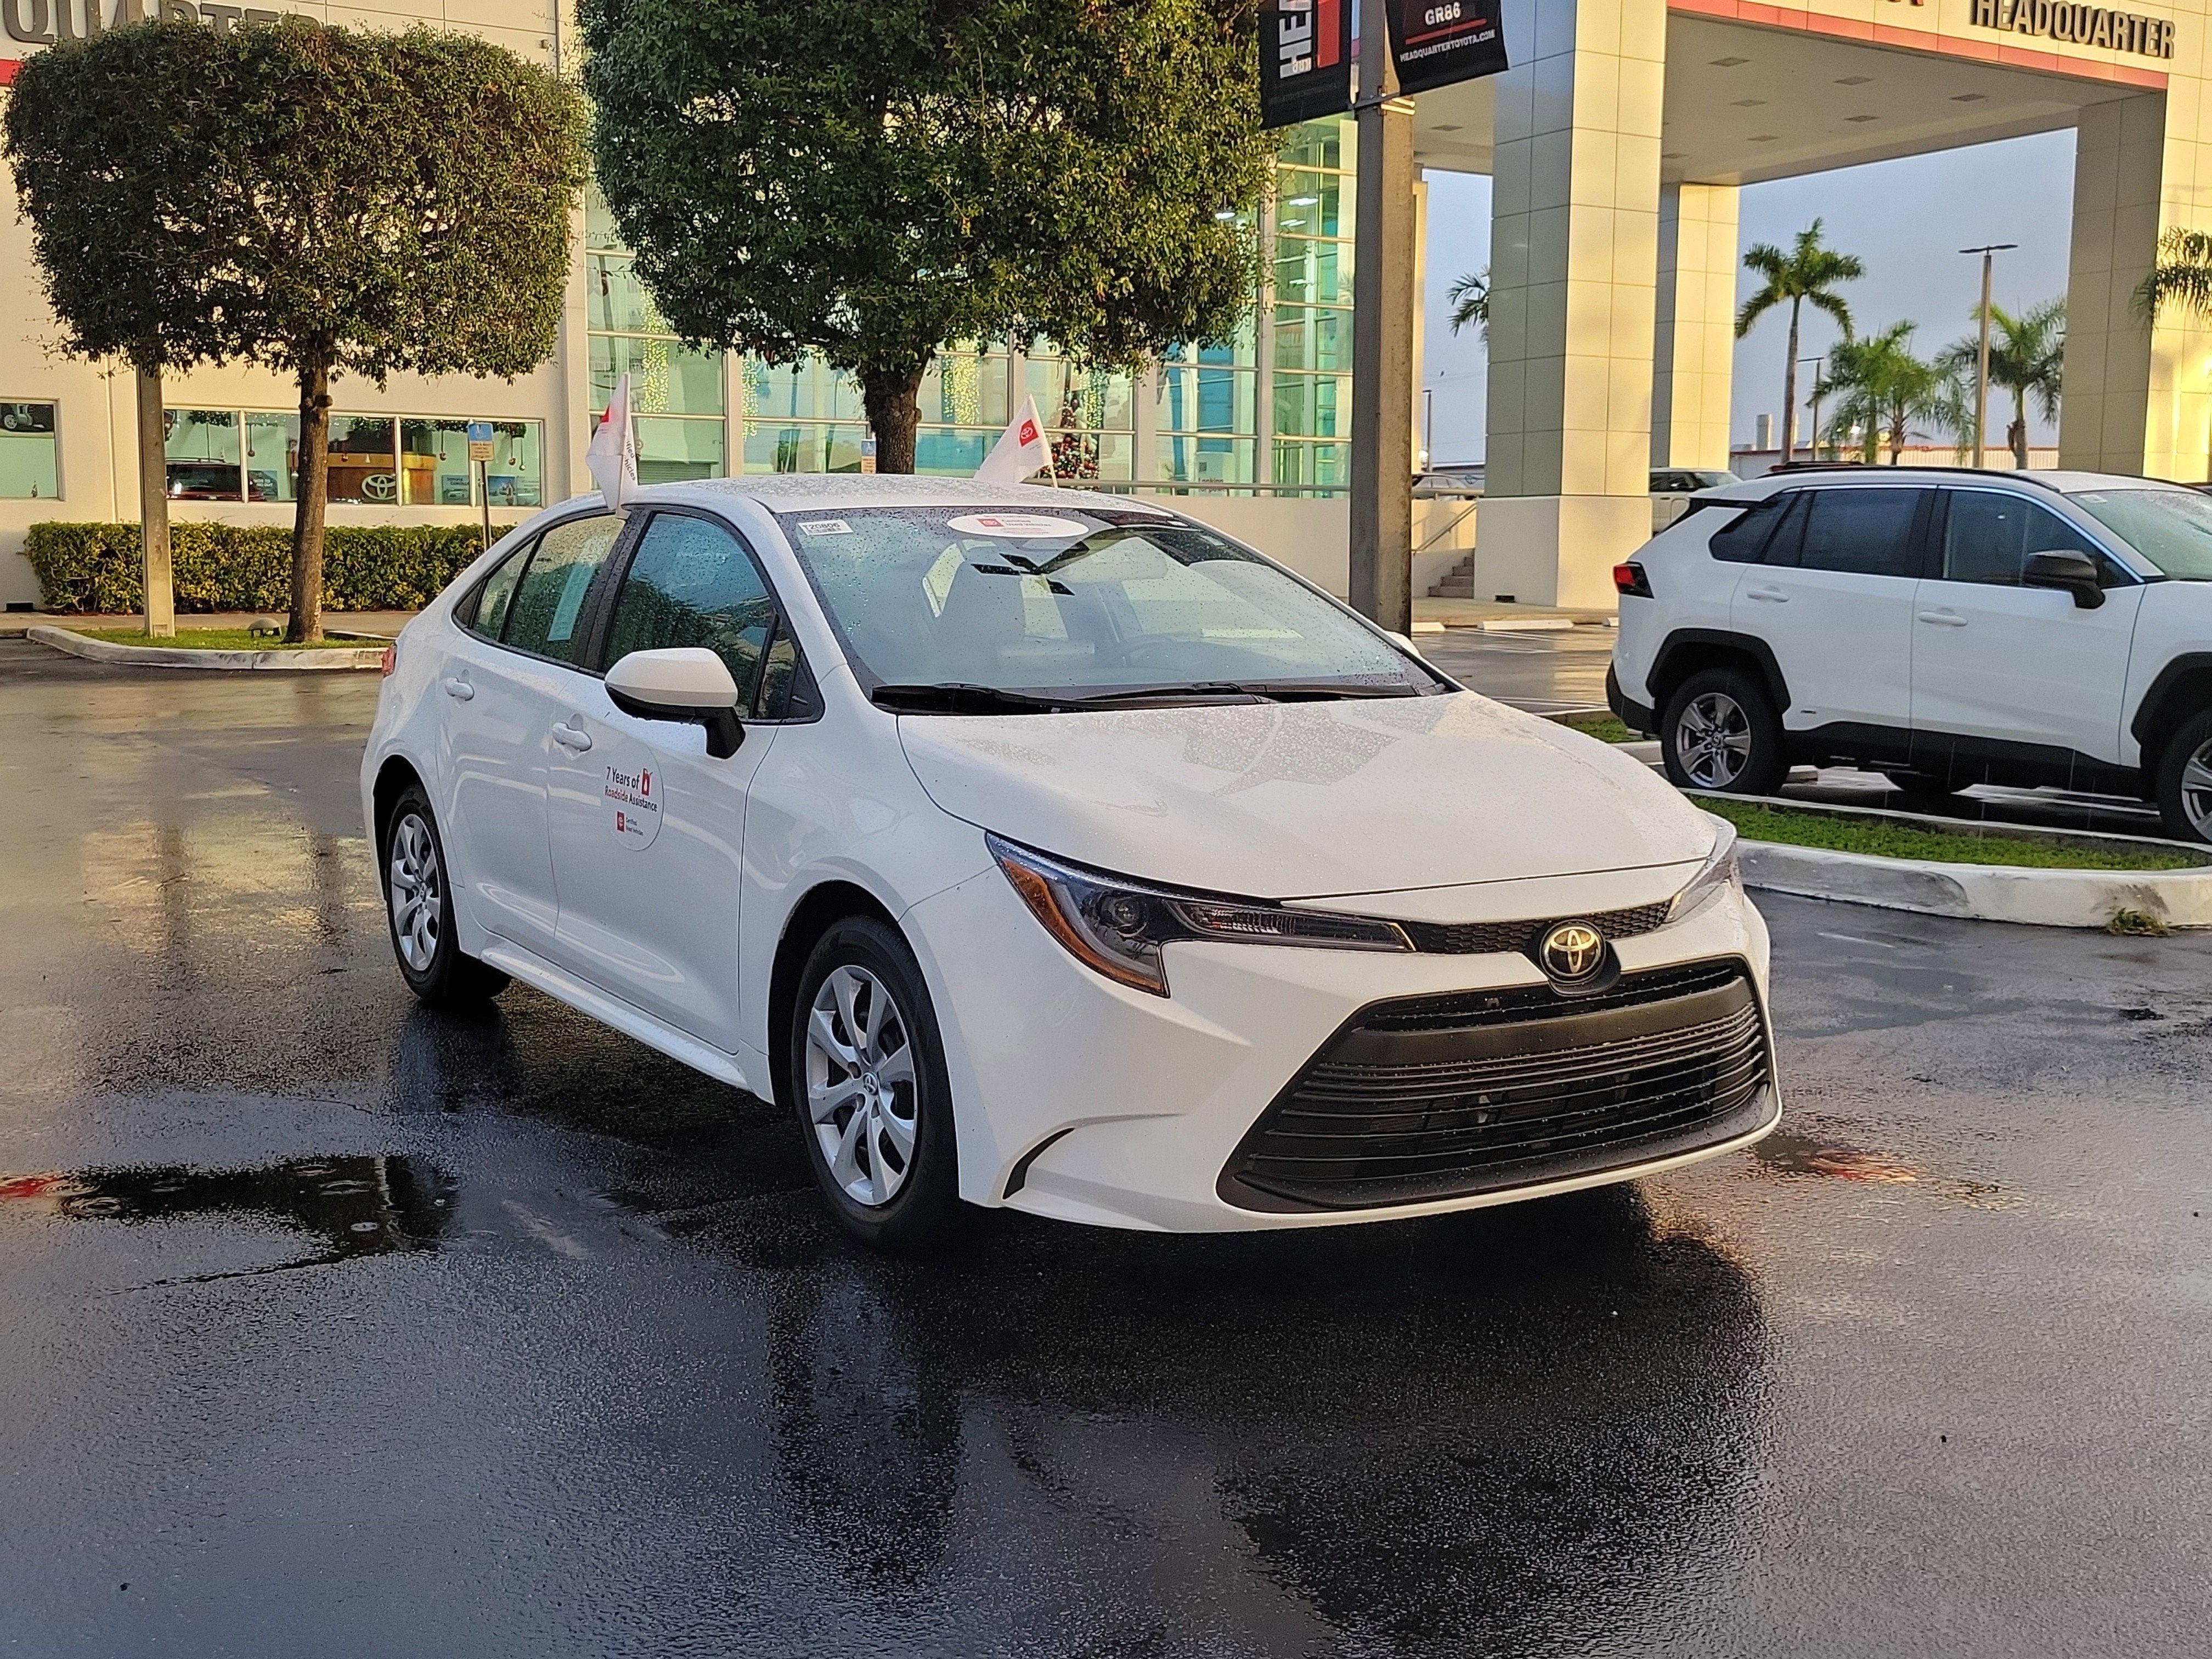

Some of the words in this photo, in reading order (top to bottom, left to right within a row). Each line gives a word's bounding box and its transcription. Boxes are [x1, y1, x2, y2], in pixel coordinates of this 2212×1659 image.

[1425, 2, 1462, 26] GR86
[1973, 0, 2176, 59] HEADQUARTER
[1400, 29, 1496, 63] HEADQUARTERTOYOTA.COM
[606, 766, 611, 780] 7
[612, 766, 630, 787] Years
[631, 774, 640, 790] of
[605, 785, 628, 803] Roadside
[629, 792, 658, 812] Assistance
